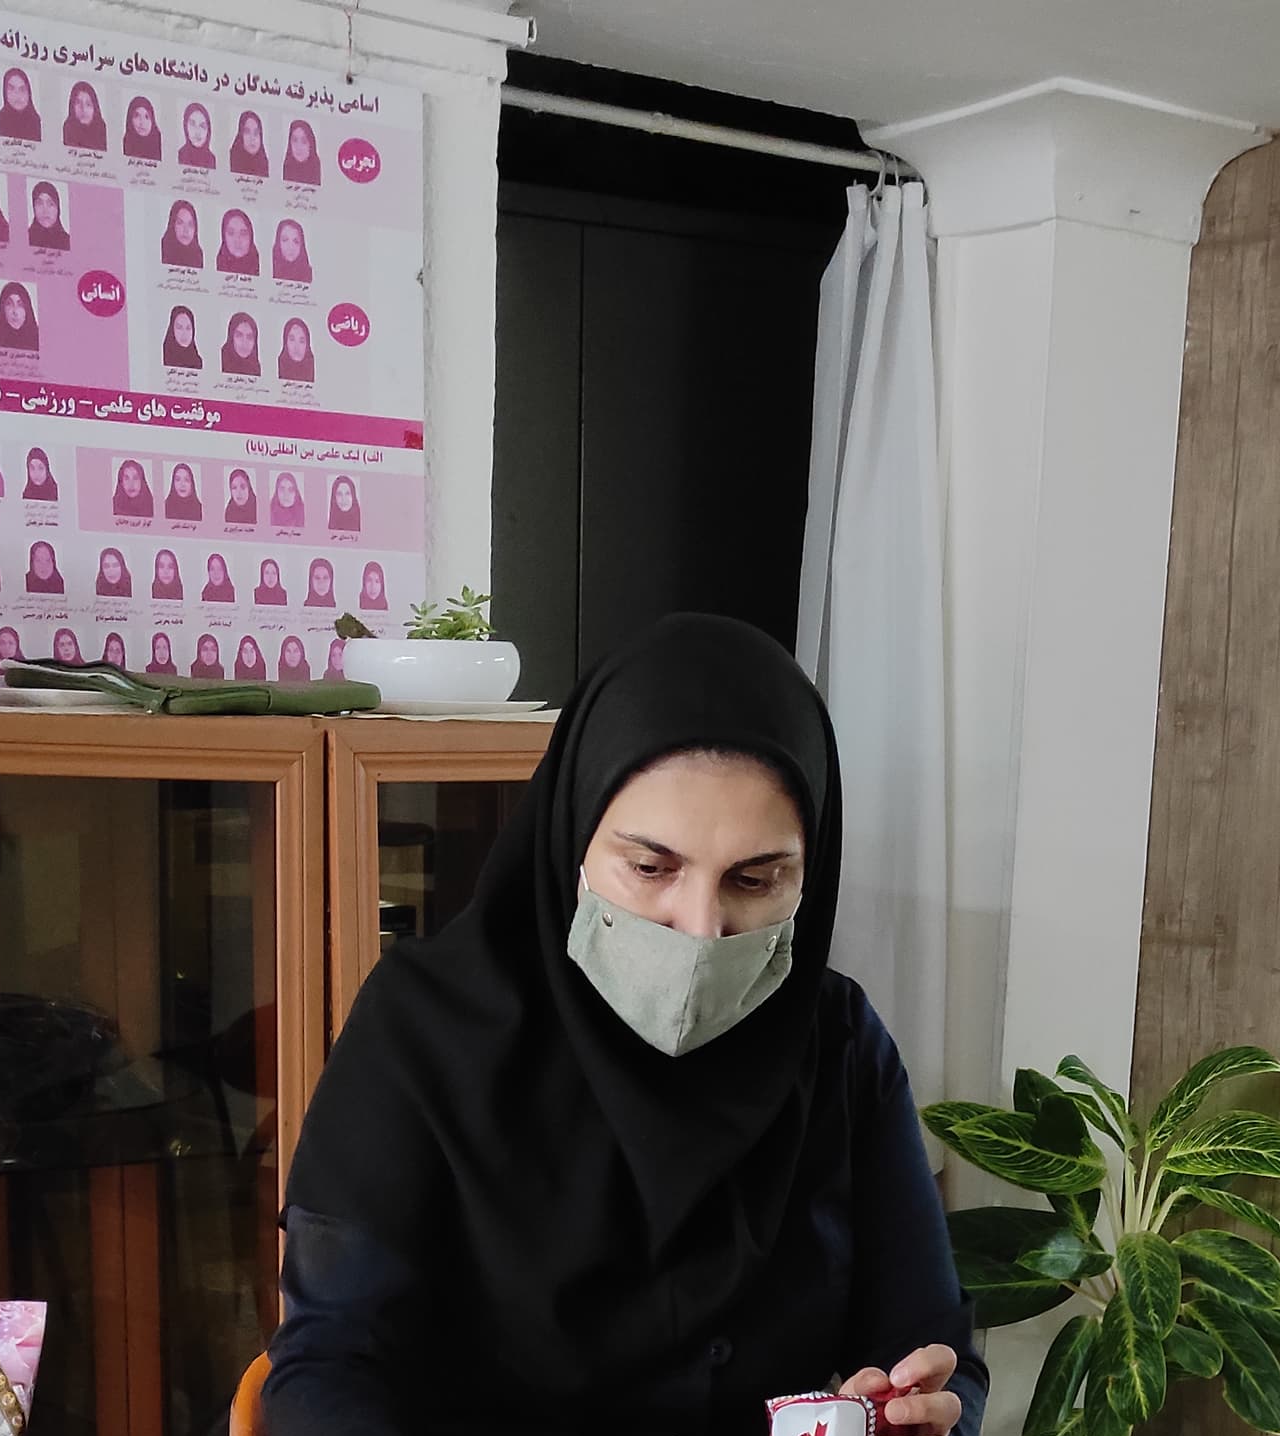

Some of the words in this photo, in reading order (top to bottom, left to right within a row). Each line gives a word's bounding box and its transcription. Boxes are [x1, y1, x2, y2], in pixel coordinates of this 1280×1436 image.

[0, 29, 48, 61] روزانه
[53, 45, 114, 71] سراسری
[119, 52, 149, 75] های
[154, 57, 208, 83] دانشگاه
[213, 73, 230, 91] در
[234, 73, 281, 96] شدگان
[338, 94, 379, 113] اسامی
[341, 151, 377, 172] تجربی
[80, 282, 121, 303] انسانی
[331, 315, 367, 337] ریاضی
[137, 398, 166, 421] های
[170, 401, 221, 428] موفقیت
[300, 448, 315, 460] بین
[316, 447, 340, 461] علمی
